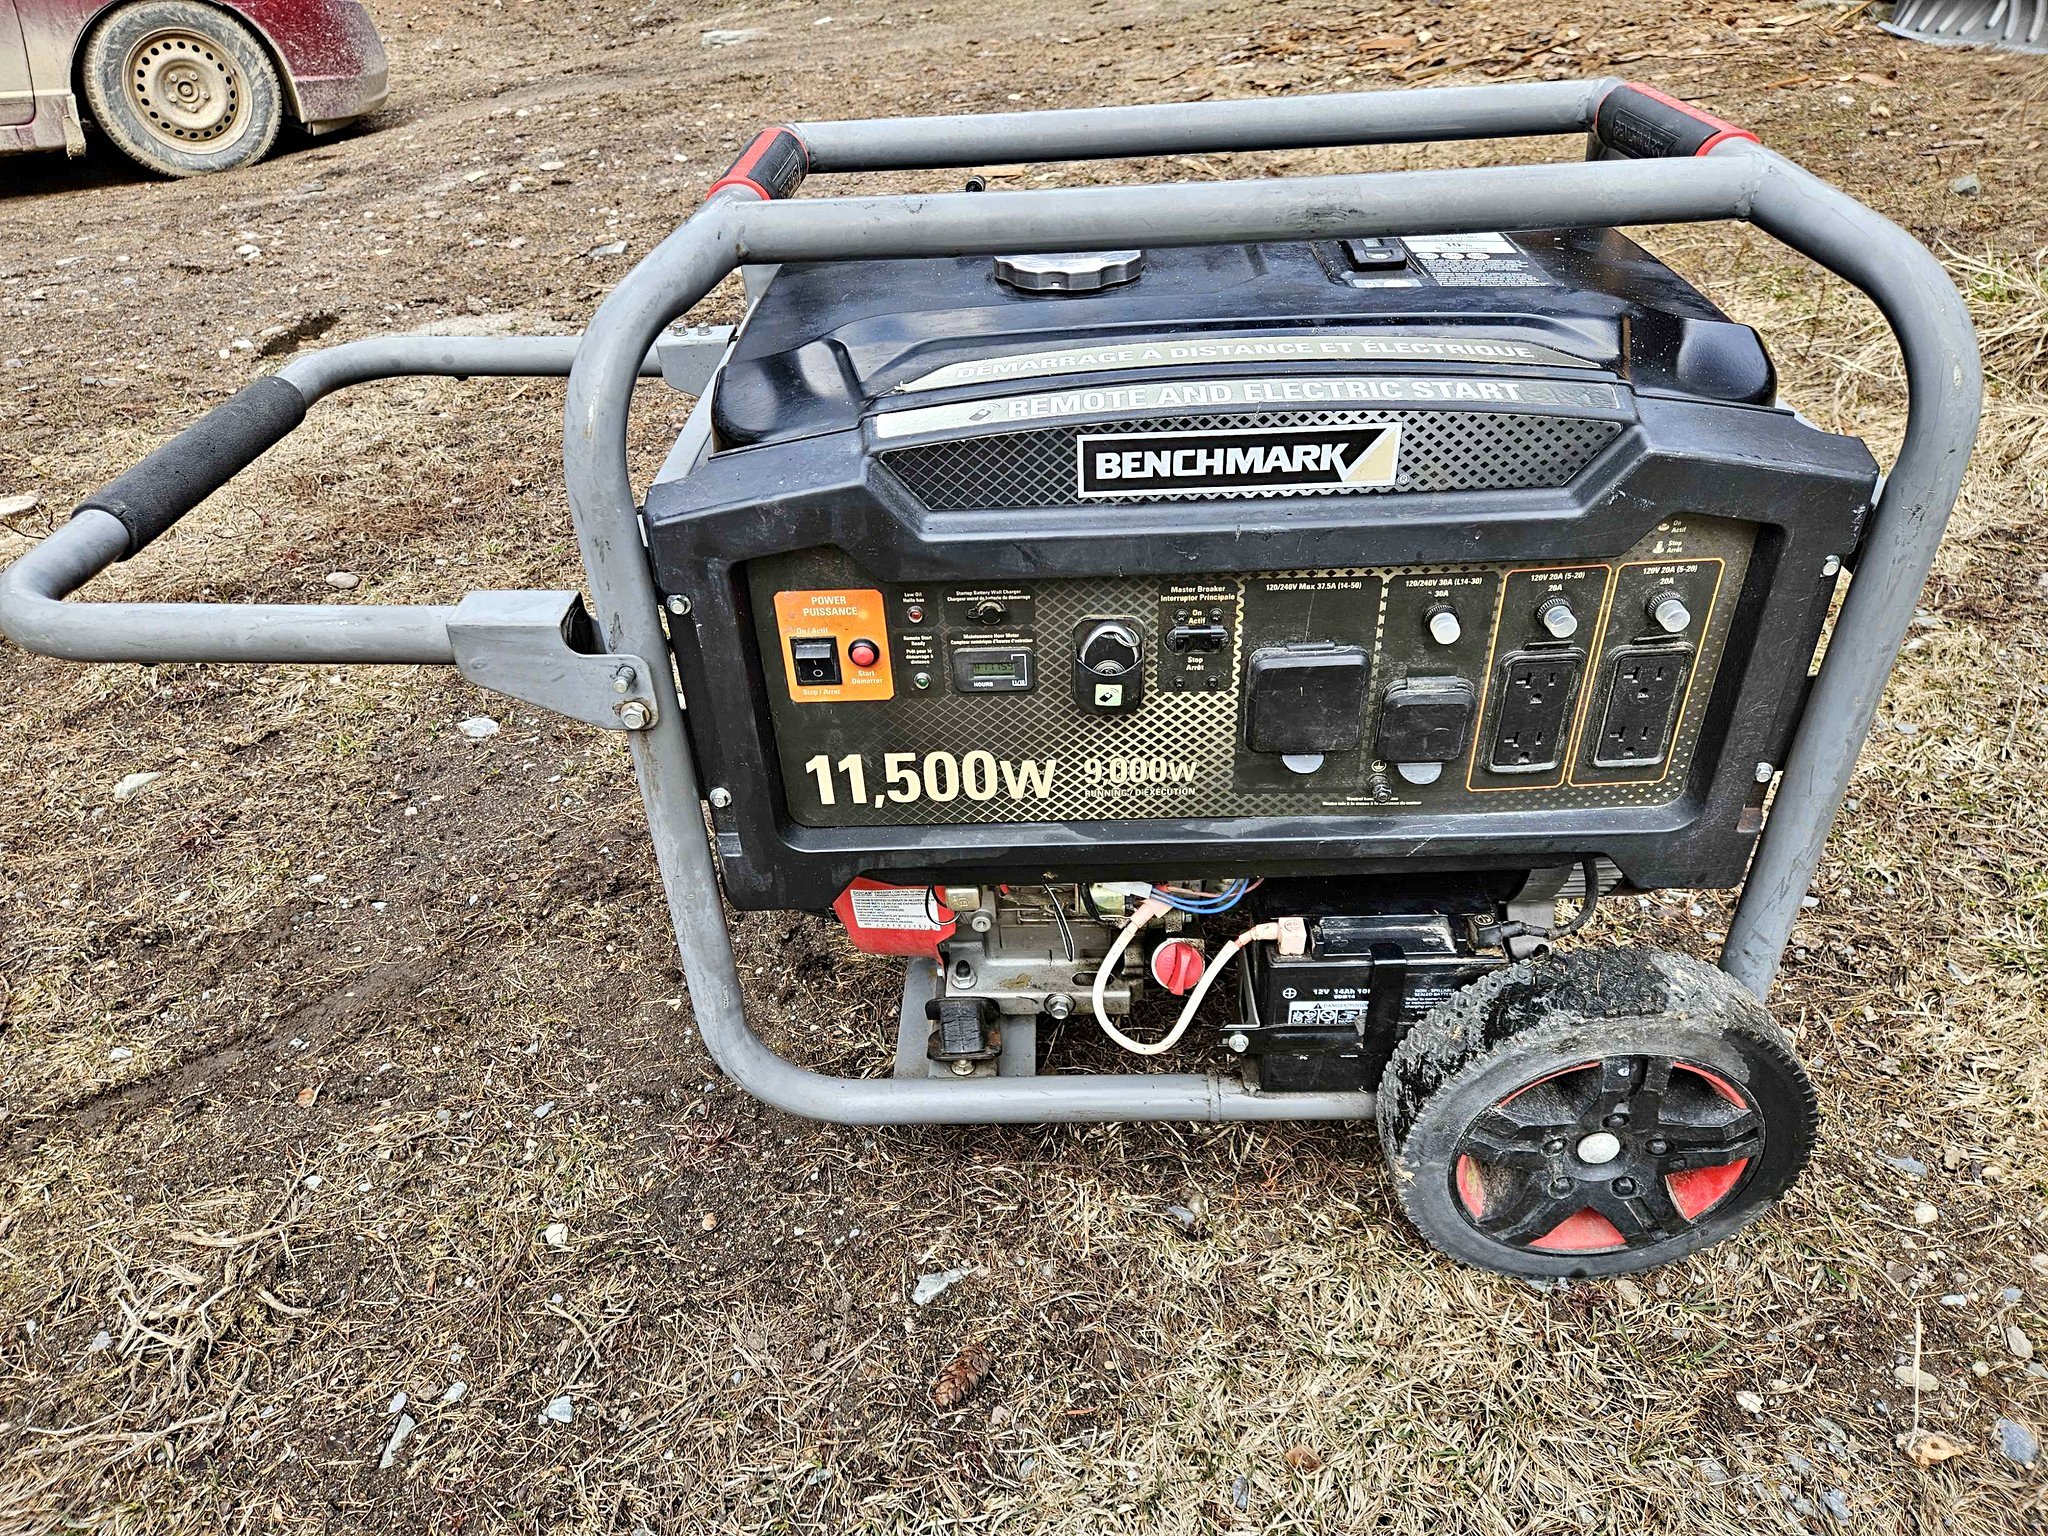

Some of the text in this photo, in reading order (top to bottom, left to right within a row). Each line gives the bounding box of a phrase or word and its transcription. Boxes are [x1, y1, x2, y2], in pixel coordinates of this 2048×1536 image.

[956, 340, 1535, 379] DÉMARRAGE À DISTANCE ET ÉLECTRIQUE
[1008, 380, 1522, 419] REMOTE AND ELECTRIC START
[1095, 442, 1350, 480] BENCHMARK
[1643, 565, 1698, 575] 120V 20A (5-20)
[1531, 571, 1586, 582] 120V 20A (5-20)
[1660, 577, 1674, 585] 20A
[1266, 583, 1298, 591] 120/240V
[1316, 582, 1336, 590] 37.5A
[1338, 581, 1362, 589] (14-50)
[1405, 579, 1437, 587] 120/240V
[1454, 577, 1482, 586] (L14-30)
[1197, 585, 1226, 593] Breaker
[811, 596, 847, 605] POWER
[1199, 593, 1236, 601] Principale
[803, 606, 859, 617] PUISSANCE
[1188, 617, 1207, 625] Actif
[1187, 656, 1204, 664] Stop
[1084, 789, 1128, 798] RUNNING
